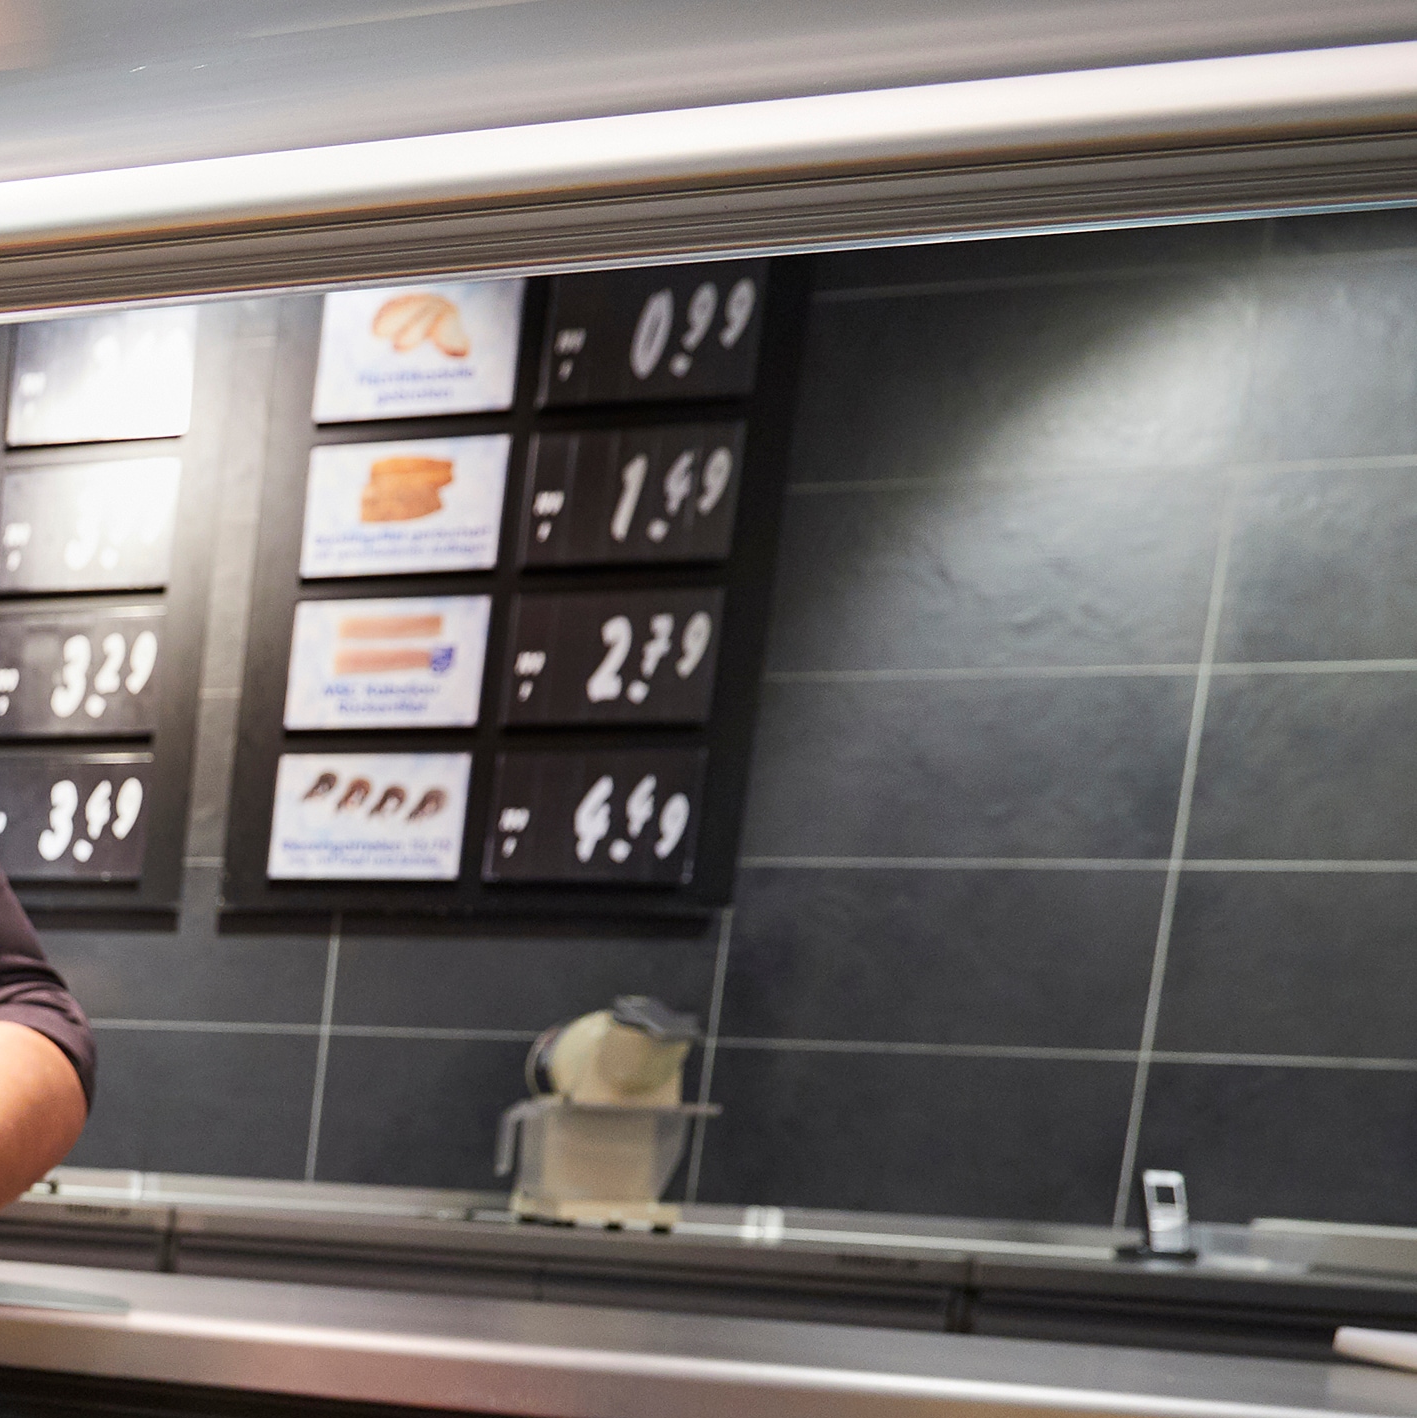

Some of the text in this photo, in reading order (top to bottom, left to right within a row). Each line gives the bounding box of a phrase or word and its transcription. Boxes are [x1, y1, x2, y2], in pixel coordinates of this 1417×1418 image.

[629, 277, 756, 380] 0.99
[611, 446, 733, 542] 1.49
[50, 630, 158, 718] 3.29
[586, 610, 712, 704] 2.79
[574, 773, 690, 863] 4.49
